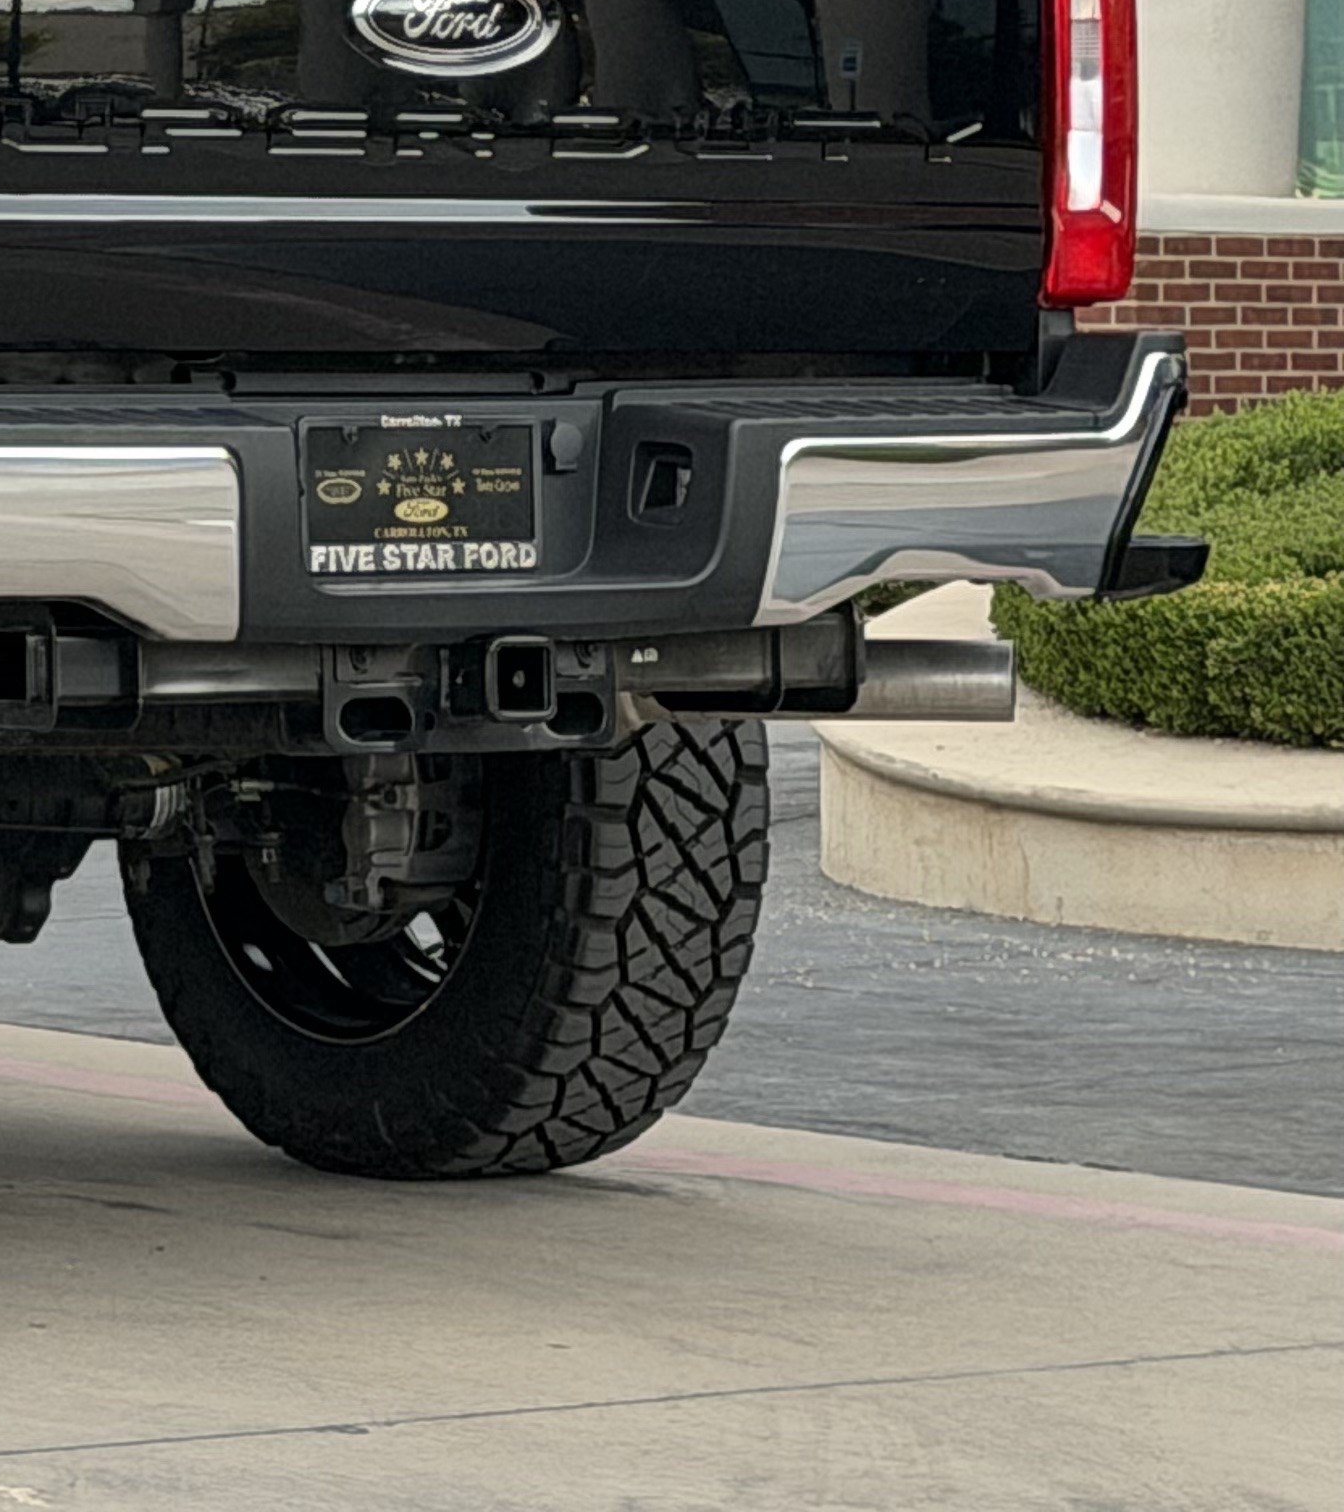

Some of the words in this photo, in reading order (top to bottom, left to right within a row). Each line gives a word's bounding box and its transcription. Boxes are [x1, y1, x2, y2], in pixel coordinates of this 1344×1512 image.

[403, 501, 441, 518] Ford
[310, 545, 376, 573] FIVE
[382, 543, 456, 572] STAR
[463, 542, 538, 570] FORD
